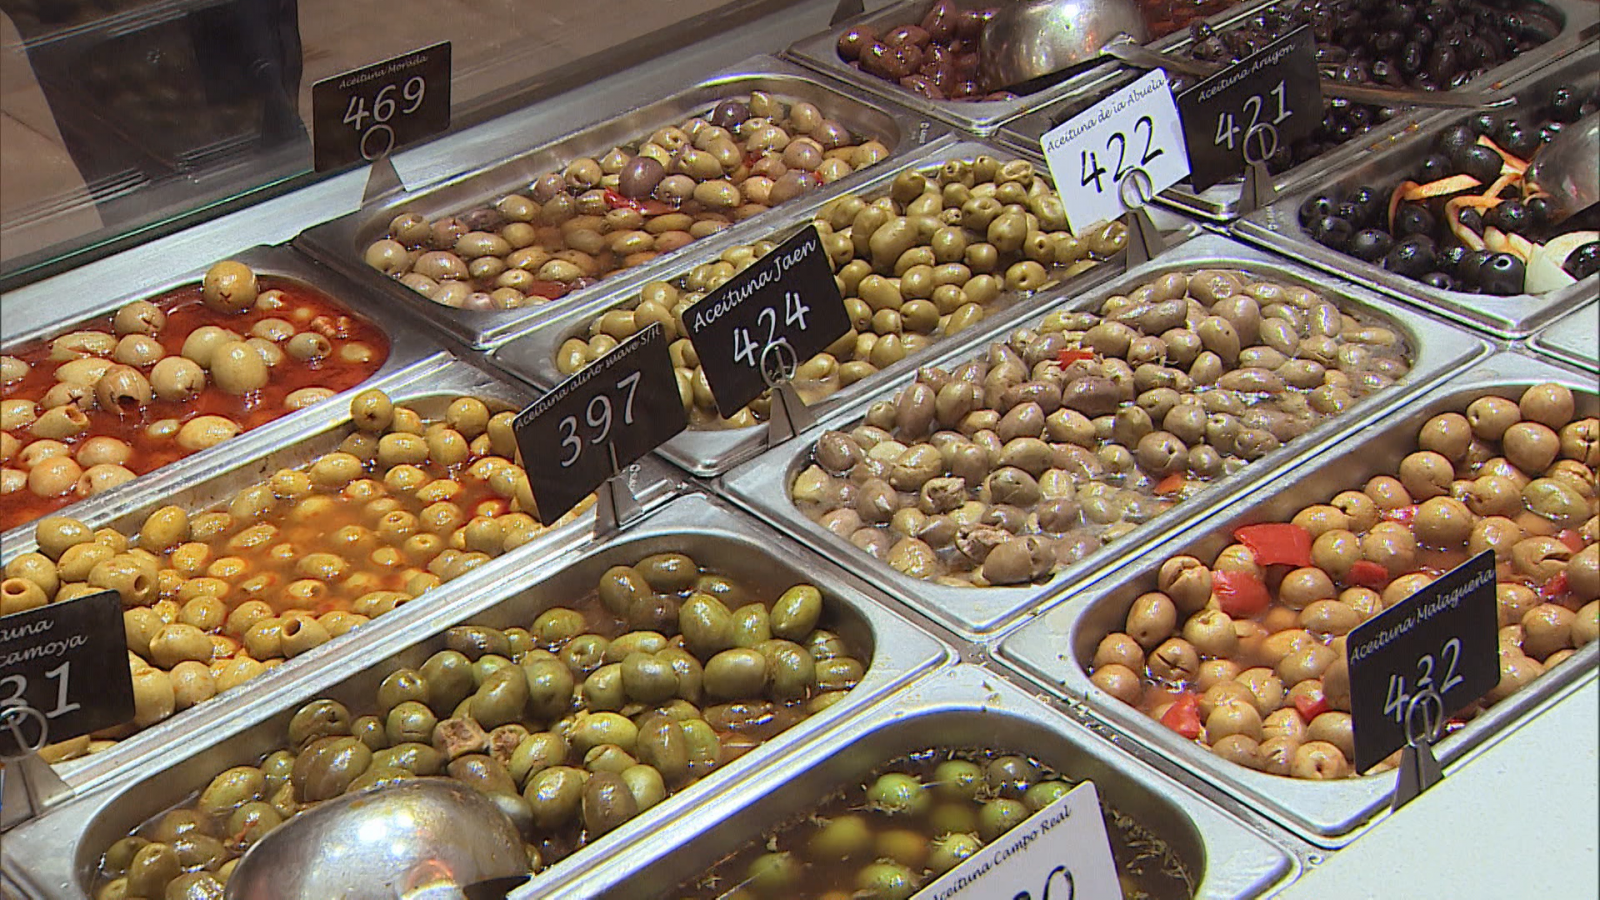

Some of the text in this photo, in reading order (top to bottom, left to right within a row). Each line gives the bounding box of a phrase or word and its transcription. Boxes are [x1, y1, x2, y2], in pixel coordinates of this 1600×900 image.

[343, 76, 426, 130] 469
[1046, 117, 1098, 153] Aceituna
[1097, 109, 1113, 123] de
[1127, 79, 1165, 106] Abuela
[1198, 68, 1250, 102] Aceituna
[1214, 79, 1293, 150] 421
[1081, 115, 1164, 193] 422
[693, 240, 816, 333] Aceituna Jaen
[733, 291, 811, 367] 424
[515, 386, 570, 432] Aceituna
[559, 371, 641, 467] 397
[1350, 569, 1495, 665] Aceituna Malagueña
[1384, 637, 1465, 723] 432
[994, 828, 1039, 866] Campo
[1040, 804, 1072, 835] Real
